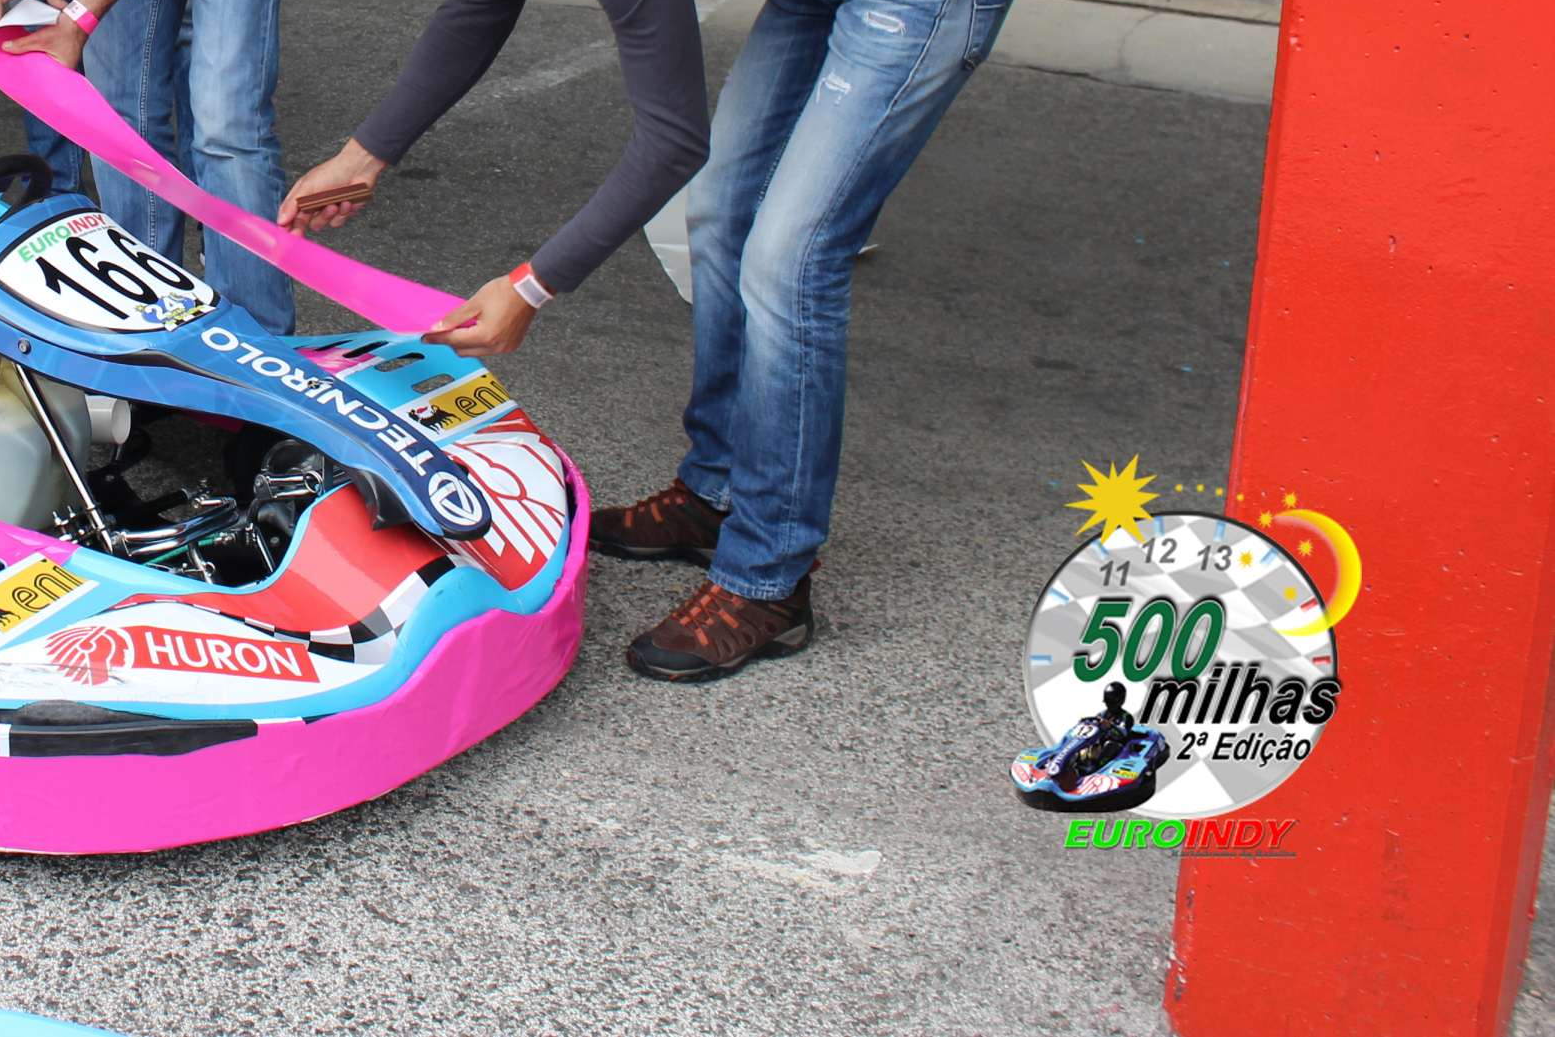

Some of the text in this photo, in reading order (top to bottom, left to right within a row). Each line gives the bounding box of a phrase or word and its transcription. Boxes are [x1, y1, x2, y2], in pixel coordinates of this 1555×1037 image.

[17, 213, 107, 263] EUROINDY
[36, 229, 195, 320] 166
[201, 326, 433, 477] TECNIROLO
[145, 631, 303, 677] HURON
